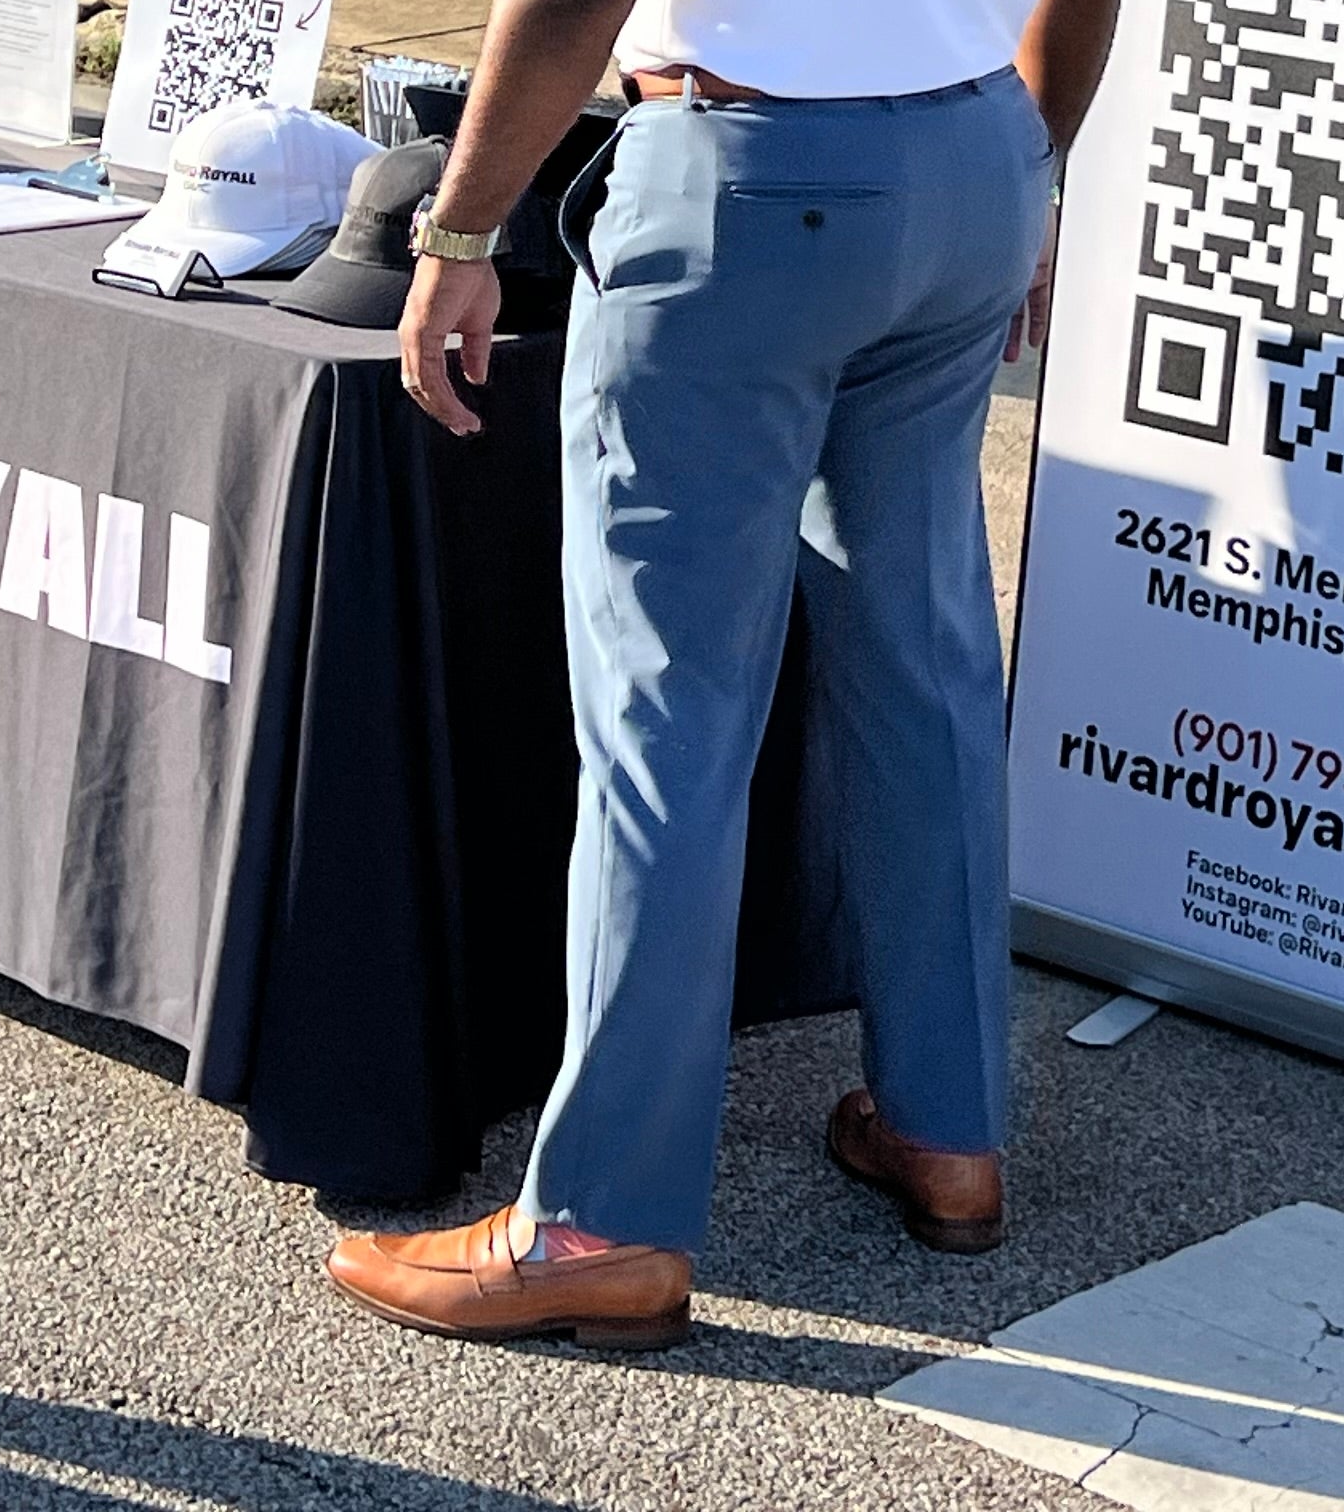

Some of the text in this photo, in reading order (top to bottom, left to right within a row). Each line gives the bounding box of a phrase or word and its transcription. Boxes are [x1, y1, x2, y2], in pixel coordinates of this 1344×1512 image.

[1115, 509, 1211, 567] 2621
[1224, 537, 1261, 580] S.
[1173, 708, 1279, 781] (901)
[1187, 850, 1292, 900] Facebook:
[1181, 899, 1275, 947] YouTube:
[1186, 877, 1298, 930] Instagram:
